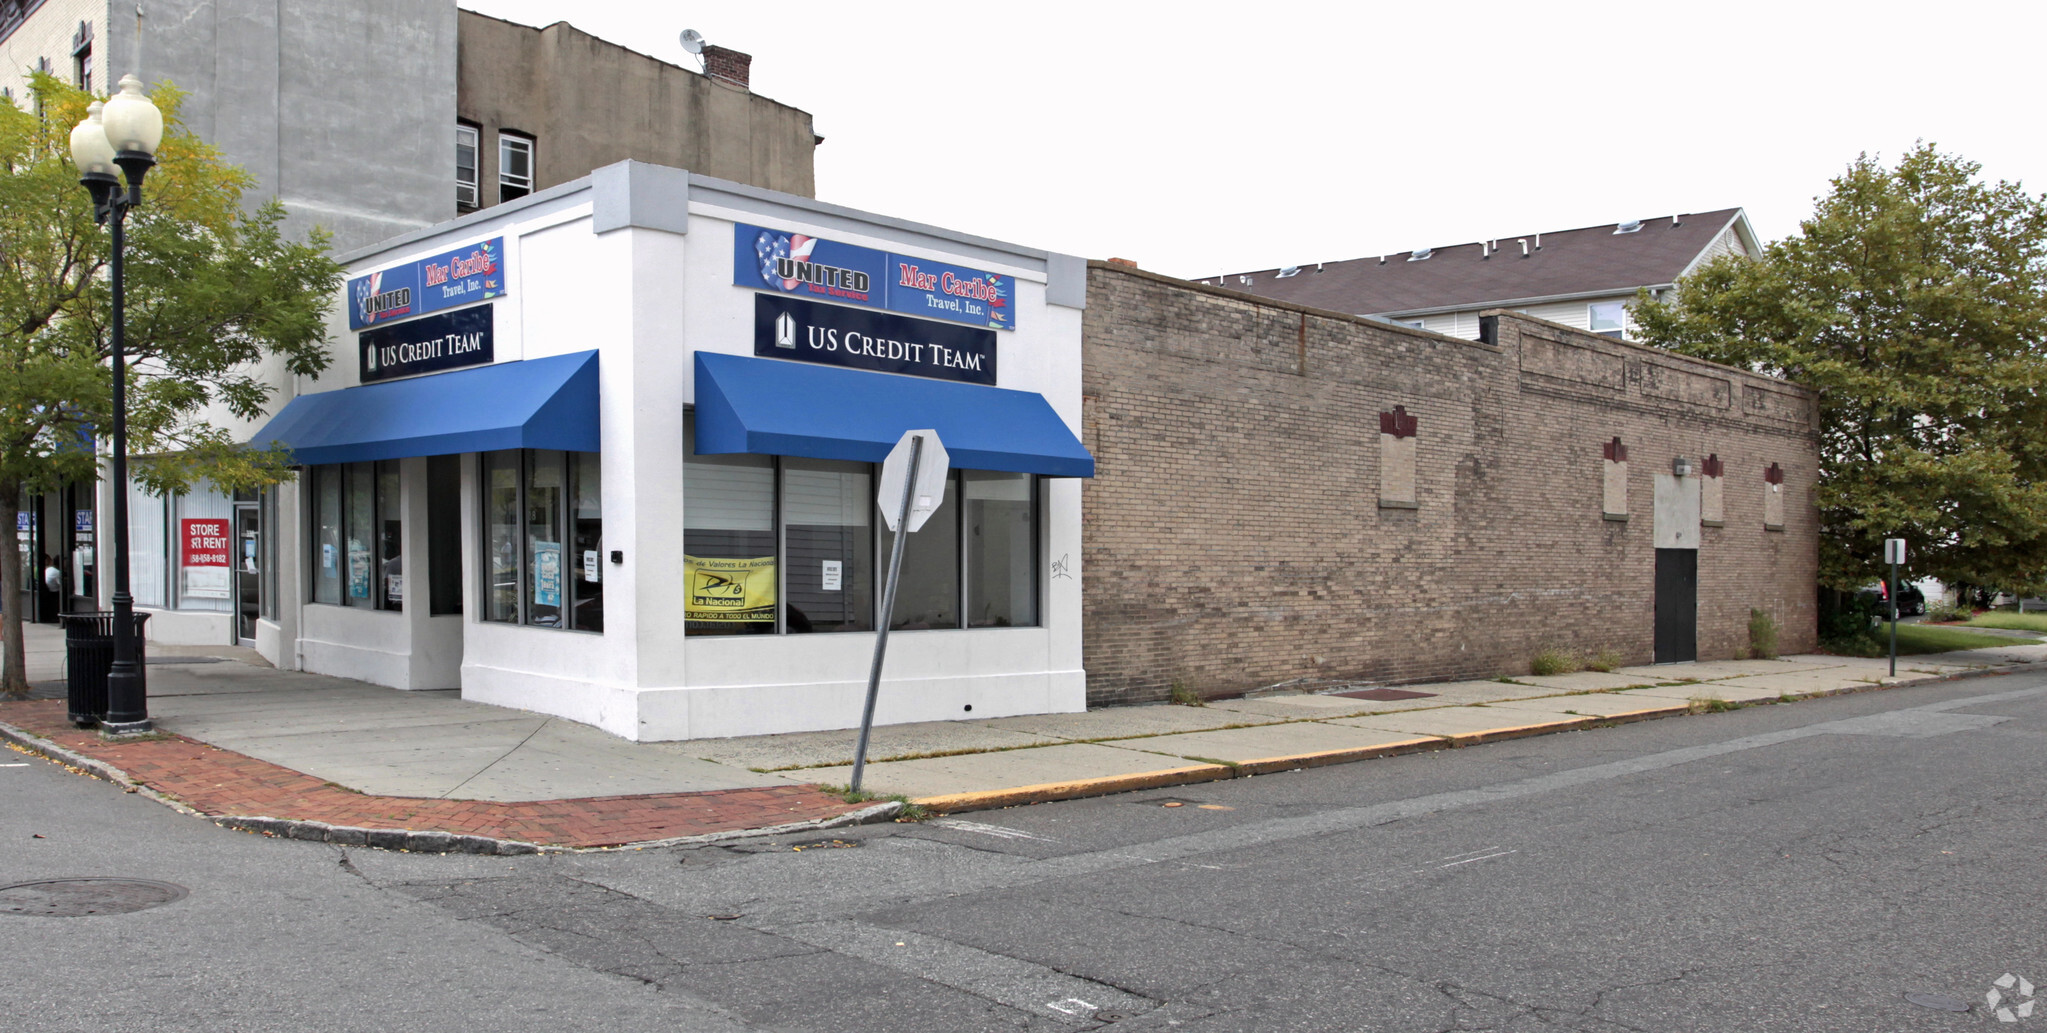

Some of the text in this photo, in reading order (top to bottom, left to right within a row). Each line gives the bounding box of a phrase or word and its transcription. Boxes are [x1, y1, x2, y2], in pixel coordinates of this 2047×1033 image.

[425, 250, 490, 287] Mar Caribe
[776, 257, 870, 293] UNITED
[442, 279, 481, 298] Travel, Inc.
[808, 283, 869, 302] Tax Service
[899, 263, 998, 303] Mar Caribe
[365, 286, 411, 315] UNITED
[926, 294, 985, 316] Travel, Inc.
[381, 345, 397, 367] US
[399, 338, 443, 363] CREDIT
[807, 326, 838, 351] US
[844, 331, 924, 363] CREDIT
[190, 524, 220, 536] STORE
[203, 537, 227, 549] RENT
[693, 597, 744, 606] La Nacional
[751, 612, 774, 620] MUNDO
